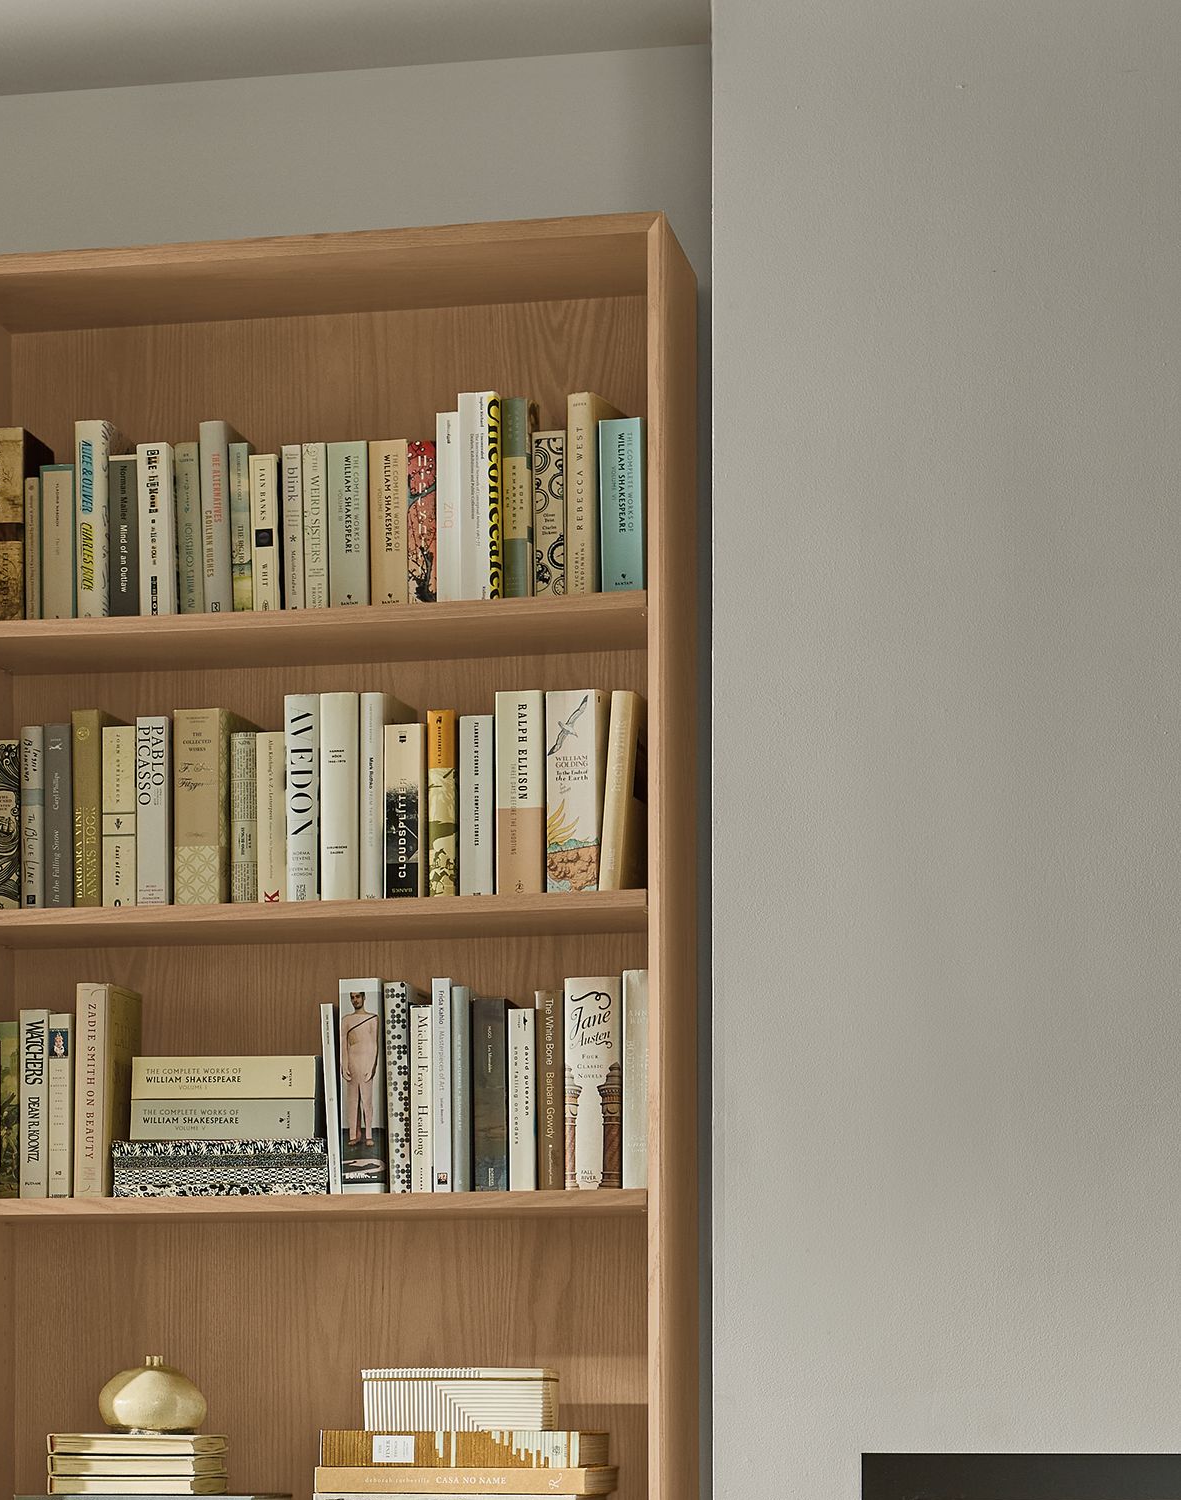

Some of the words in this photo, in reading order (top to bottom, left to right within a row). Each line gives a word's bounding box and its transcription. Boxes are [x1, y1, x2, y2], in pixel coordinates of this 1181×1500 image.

[81, 440, 93, 466] ALICE
[618, 432, 626, 471] WILLIAM
[82, 467, 93, 476] &
[120, 464, 128, 495] Norman
[287, 467, 299, 502] blink
[344, 455, 352, 493] WILLIAM
[82, 477, 94, 513] OLIVER
[120, 497, 128, 520] Mailer
[310, 475, 320, 515] WEIRD
[618, 475, 626, 533] SHAKESPEARE
[82, 523, 94, 563] CHARLES
[120, 524, 128, 543] Mind
[310, 518, 321, 563] SISTERS
[345, 497, 353, 554] SHAKESPEARE
[120, 544, 128, 553] of
[120, 553, 128, 565] an
[120, 567, 128, 592] Outlaw
[518, 704, 527, 743] RALPH
[138, 726, 151, 806] PICASSO
[151, 725, 164, 786] PABLO
[290, 706, 314, 837] AVEDON
[518, 749, 528, 799] ELLISON
[87, 1003, 97, 1041] ZADIE
[546, 998, 554, 1014] The
[570, 1006, 611, 1041] Jane
[417, 1014, 428, 1060] Michael
[545, 1016, 554, 1042] White
[25, 1020, 44, 1086] WATCHERS
[87, 1046, 96, 1085] SMITH
[545, 1044, 554, 1066] Bone
[415, 1065, 428, 1096] Frayn
[438, 1071, 446, 1079] of
[438, 1080, 446, 1091] Art
[546, 1072, 555, 1105] Barbara
[28, 1097, 40, 1119] DEAN
[86, 1090, 95, 1106] ON
[28, 1121, 39, 1129] R.
[85, 1112, 95, 1160] BEAUTY
[414, 1104, 428, 1156] Headlong
[544, 1107, 555, 1139] Gowdy
